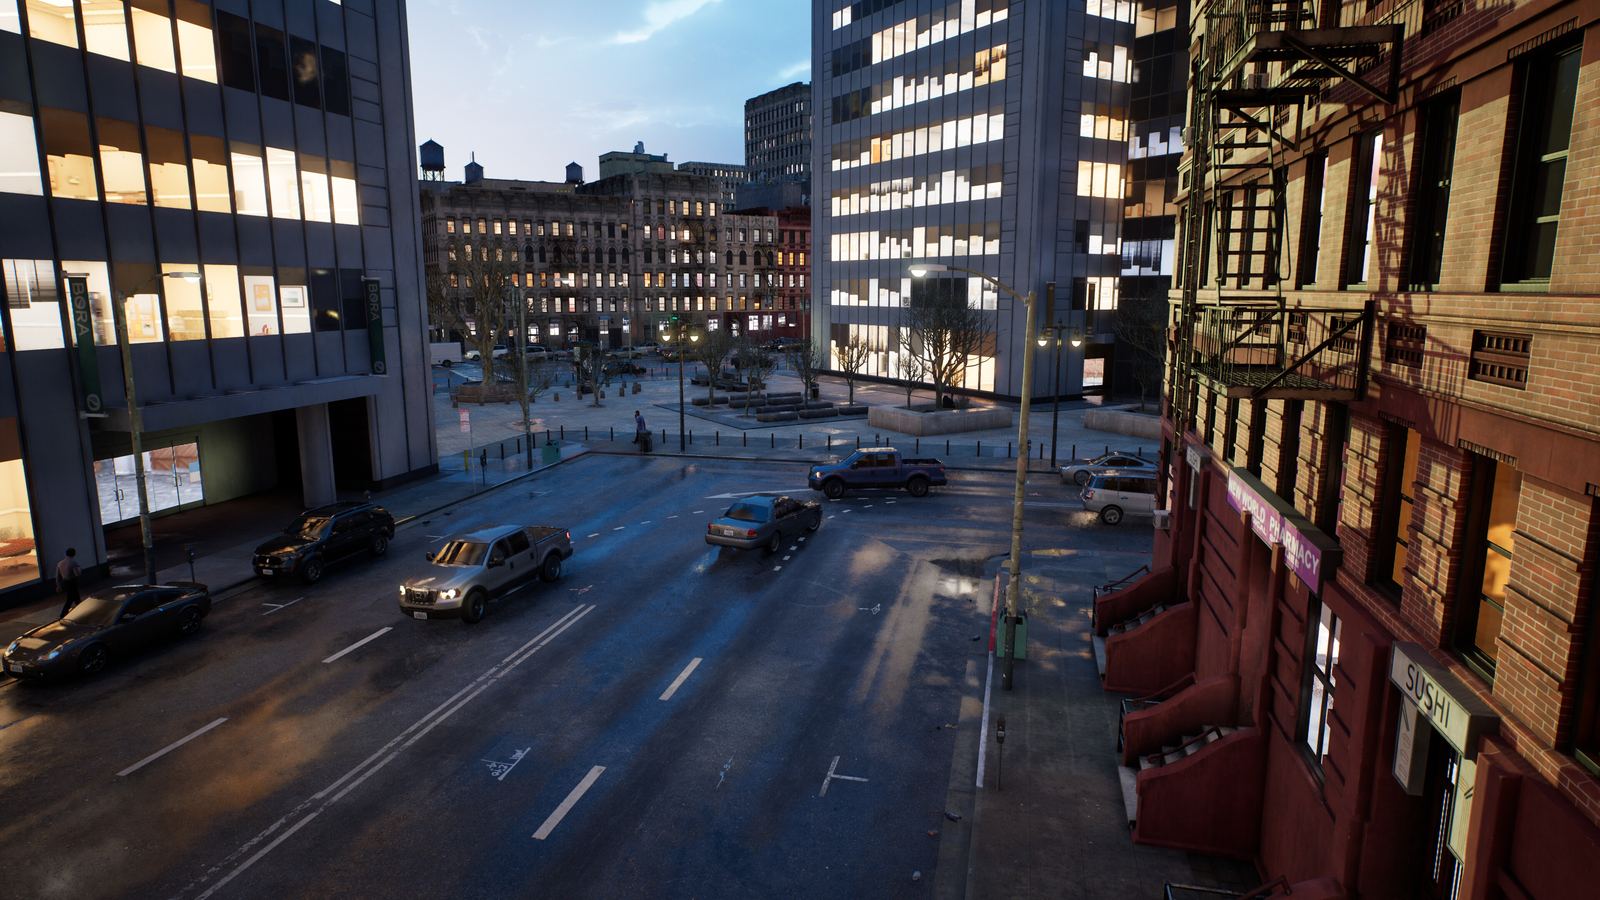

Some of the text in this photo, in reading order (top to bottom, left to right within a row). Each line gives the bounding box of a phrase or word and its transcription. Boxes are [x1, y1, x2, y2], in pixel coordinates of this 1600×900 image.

[1242, 491, 1266, 524] WORLD
[1270, 515, 1320, 576] PHARMACY
[1405, 663, 1451, 729] SUSHI
